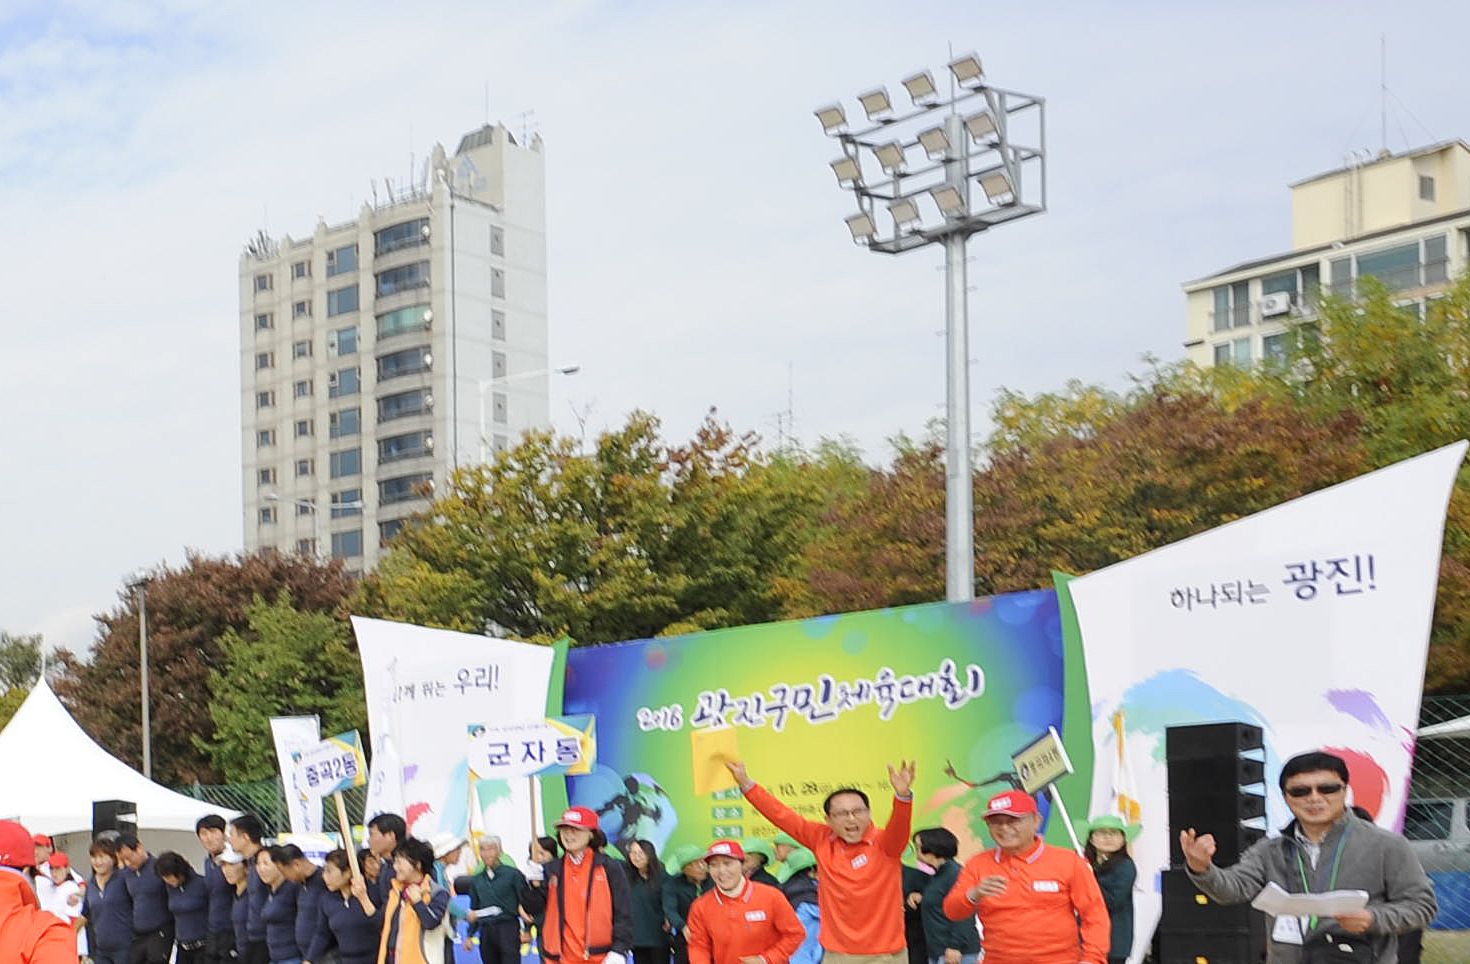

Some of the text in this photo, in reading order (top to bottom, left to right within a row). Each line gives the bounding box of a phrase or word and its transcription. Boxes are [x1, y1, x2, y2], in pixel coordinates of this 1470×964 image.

[1169, 554, 1377, 612] 하나되는 광진!
[452, 663, 500, 696] 우리!
[638, 704, 682, 730] 2016
